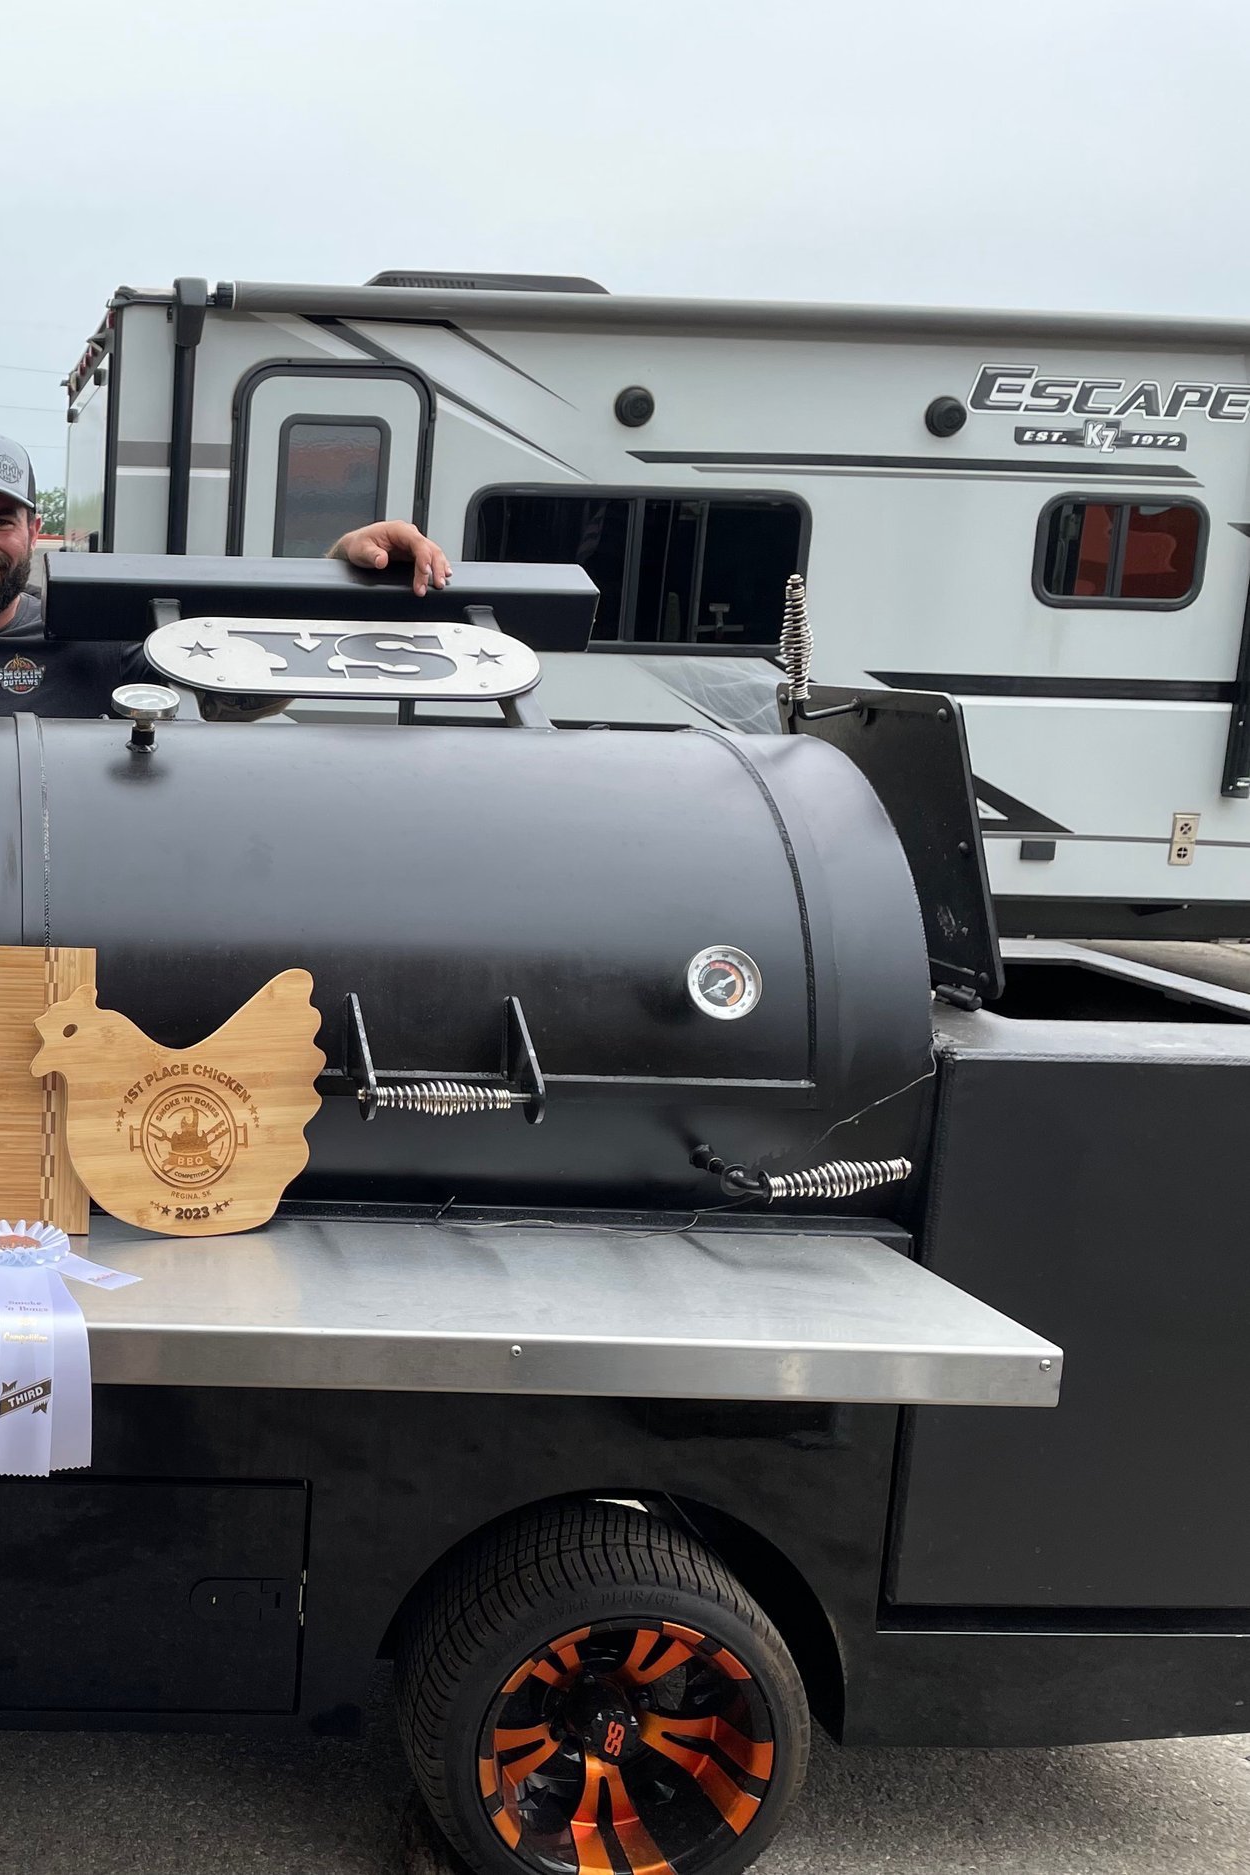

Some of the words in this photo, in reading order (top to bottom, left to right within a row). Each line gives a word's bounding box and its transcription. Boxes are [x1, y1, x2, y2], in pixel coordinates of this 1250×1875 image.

[968, 364, 1250, 422] ESCAPE
[1023, 430, 1068, 443] EST.
[1085, 421, 1119, 453] KZ
[1130, 433, 1181, 447] 1972
[227, 630, 458, 682] YS
[3, 679, 39, 687] OUTLAWS
[123, 1081, 144, 1105] 1ST
[143, 1064, 190, 1087] PLACE
[192, 1064, 252, 1104] CHICKEN
[155, 1098, 181, 1122] SMOKE
[194, 1097, 220, 1119] BONES
[177, 1156, 204, 1166] BBQ
[174, 1169, 210, 1179] COMPETITION
[171, 1190, 201, 1200] REGINA,
[202, 1190, 212, 1198] SK
[175, 1206, 210, 1220] 2023
[3, 1331, 49, 1345] Competition
[7, 1386, 44, 1408] THIRD
[604, 1721, 626, 1757] SS
